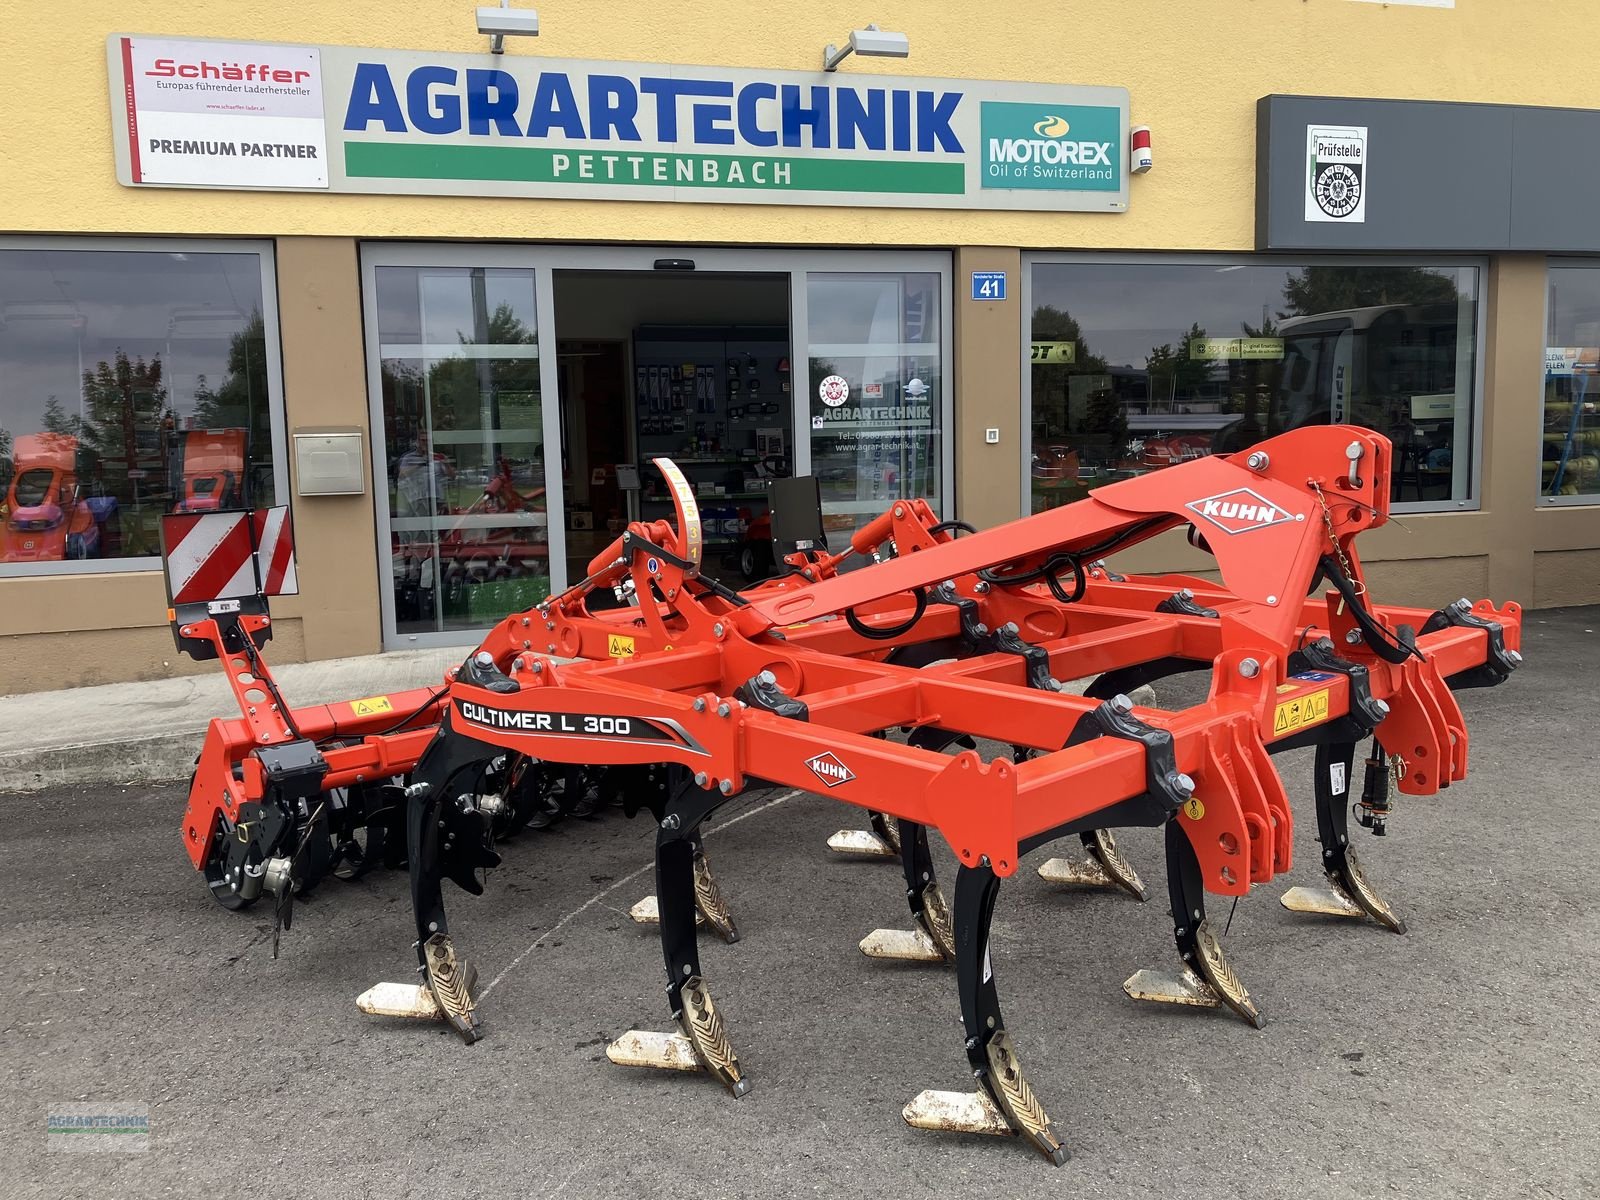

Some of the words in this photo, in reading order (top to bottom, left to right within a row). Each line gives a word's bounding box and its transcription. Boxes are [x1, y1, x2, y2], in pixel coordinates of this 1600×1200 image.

[145, 58, 310, 83] Schäffer
[156, 80, 194, 91] Europas
[196, 82, 242, 93] führender
[243, 84, 311, 96] Laderhersteller
[343, 63, 965, 153] AGRARTECHNIK
[149, 138, 237, 156] PREMIUM
[240, 142, 318, 159] PARTNER
[989, 138, 1112, 166] MOTOREX
[1318, 142, 1361, 157] Prüfstelle
[553, 154, 792, 185] PETTENBACH
[989, 164, 1008, 177] Oil
[1014, 165, 1028, 177] of
[1033, 166, 1113, 180] Switzerland
[980, 280, 998, 297] 41
[823, 405, 931, 420] AGRARTECHNIK
[835, 441, 920, 452] www.agrar-technik.at
[1202, 500, 1276, 523] KUHN
[690, 527, 697, 538] 3
[691, 547, 697, 558] 1
[463, 702, 552, 730] CULTIMER
[561, 716, 575, 731] L
[584, 717, 630, 735] 300
[813, 759, 847, 780] KUHN
